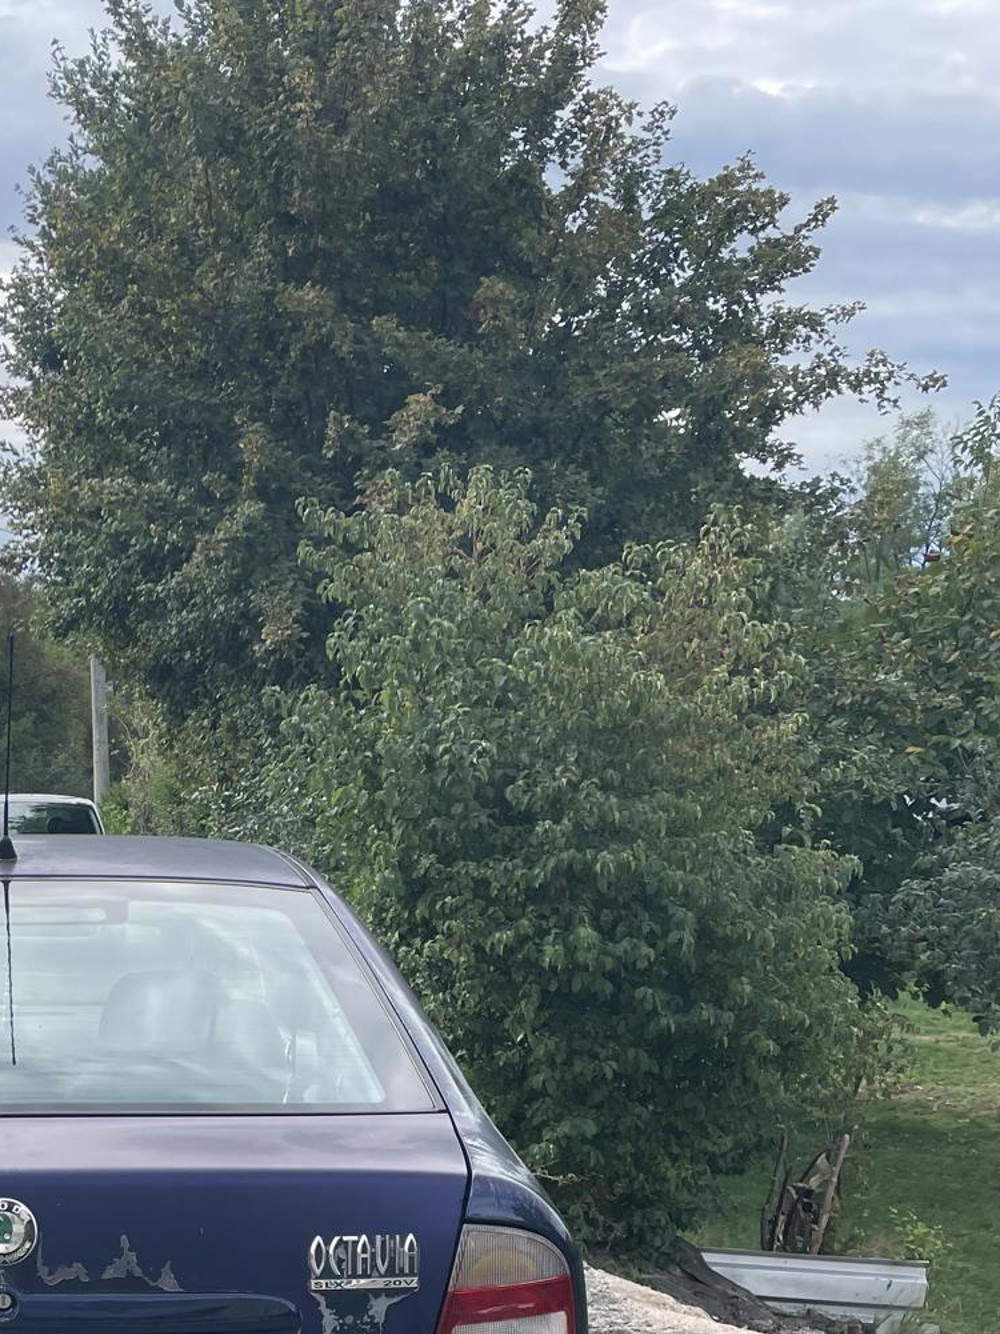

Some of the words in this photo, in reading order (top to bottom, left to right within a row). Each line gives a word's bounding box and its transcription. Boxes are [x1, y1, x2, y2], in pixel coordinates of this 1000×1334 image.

[310, 1233, 418, 1276] OCTAVIA
[313, 1280, 345, 1289] SLX
[383, 1278, 415, 1287] 20V
